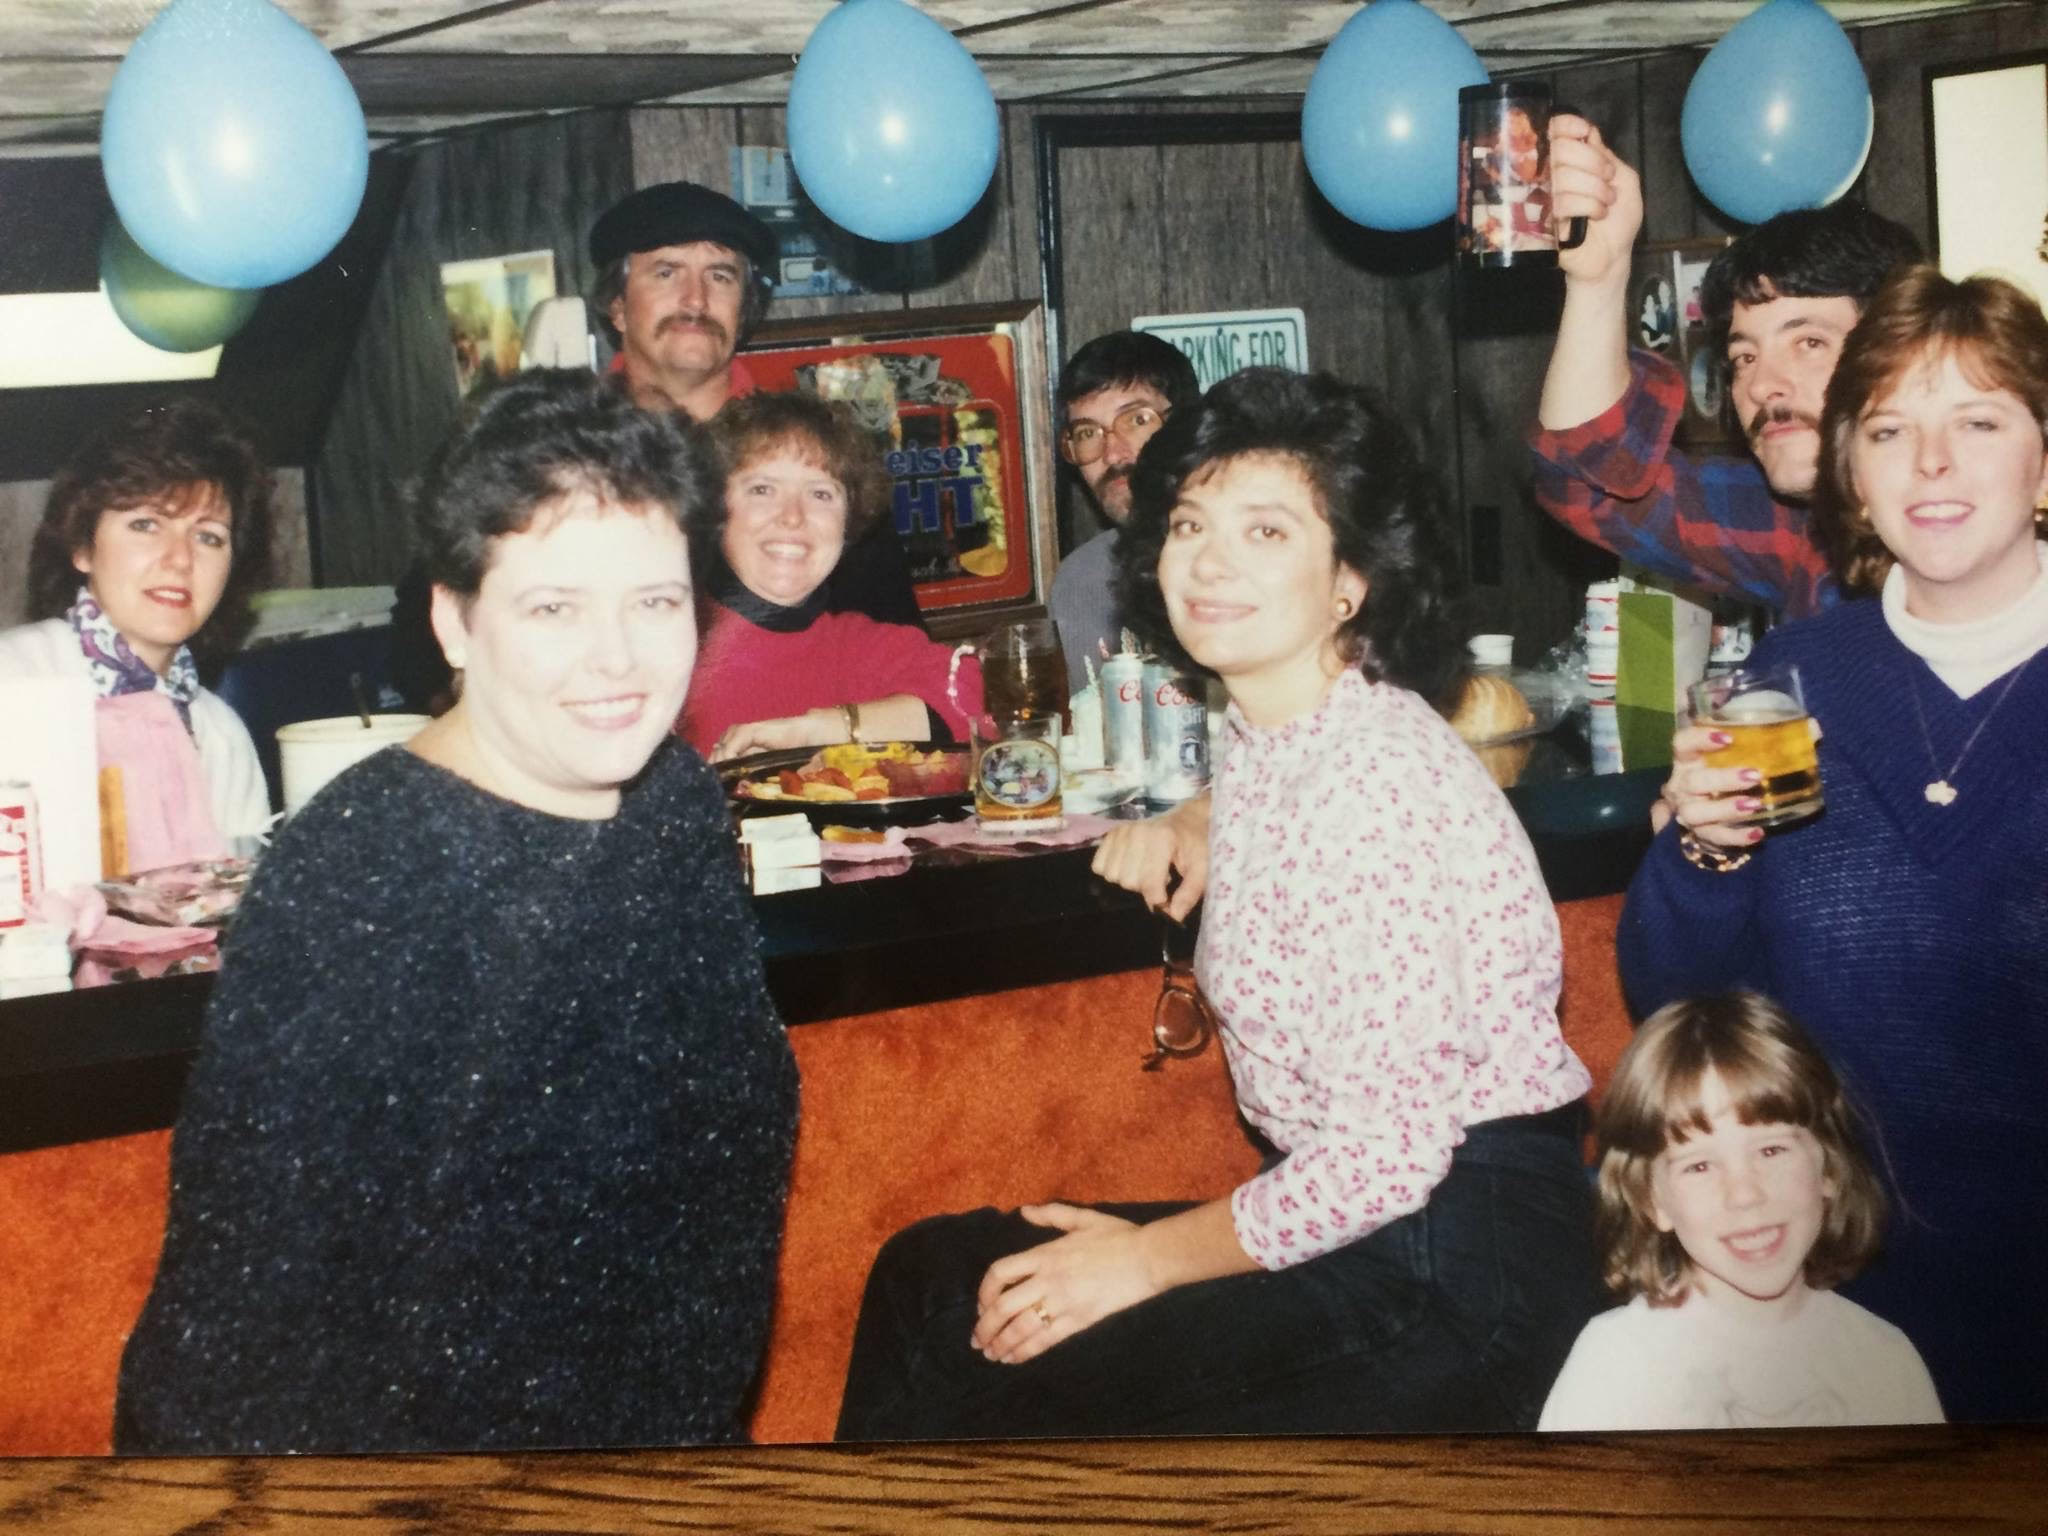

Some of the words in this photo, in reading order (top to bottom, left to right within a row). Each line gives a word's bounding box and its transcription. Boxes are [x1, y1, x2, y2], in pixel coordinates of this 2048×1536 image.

[1171, 332, 1241, 383] RKING
[1249, 330, 1287, 367] FOR
[886, 439, 983, 474] eiser
[893, 476, 984, 535] HT
